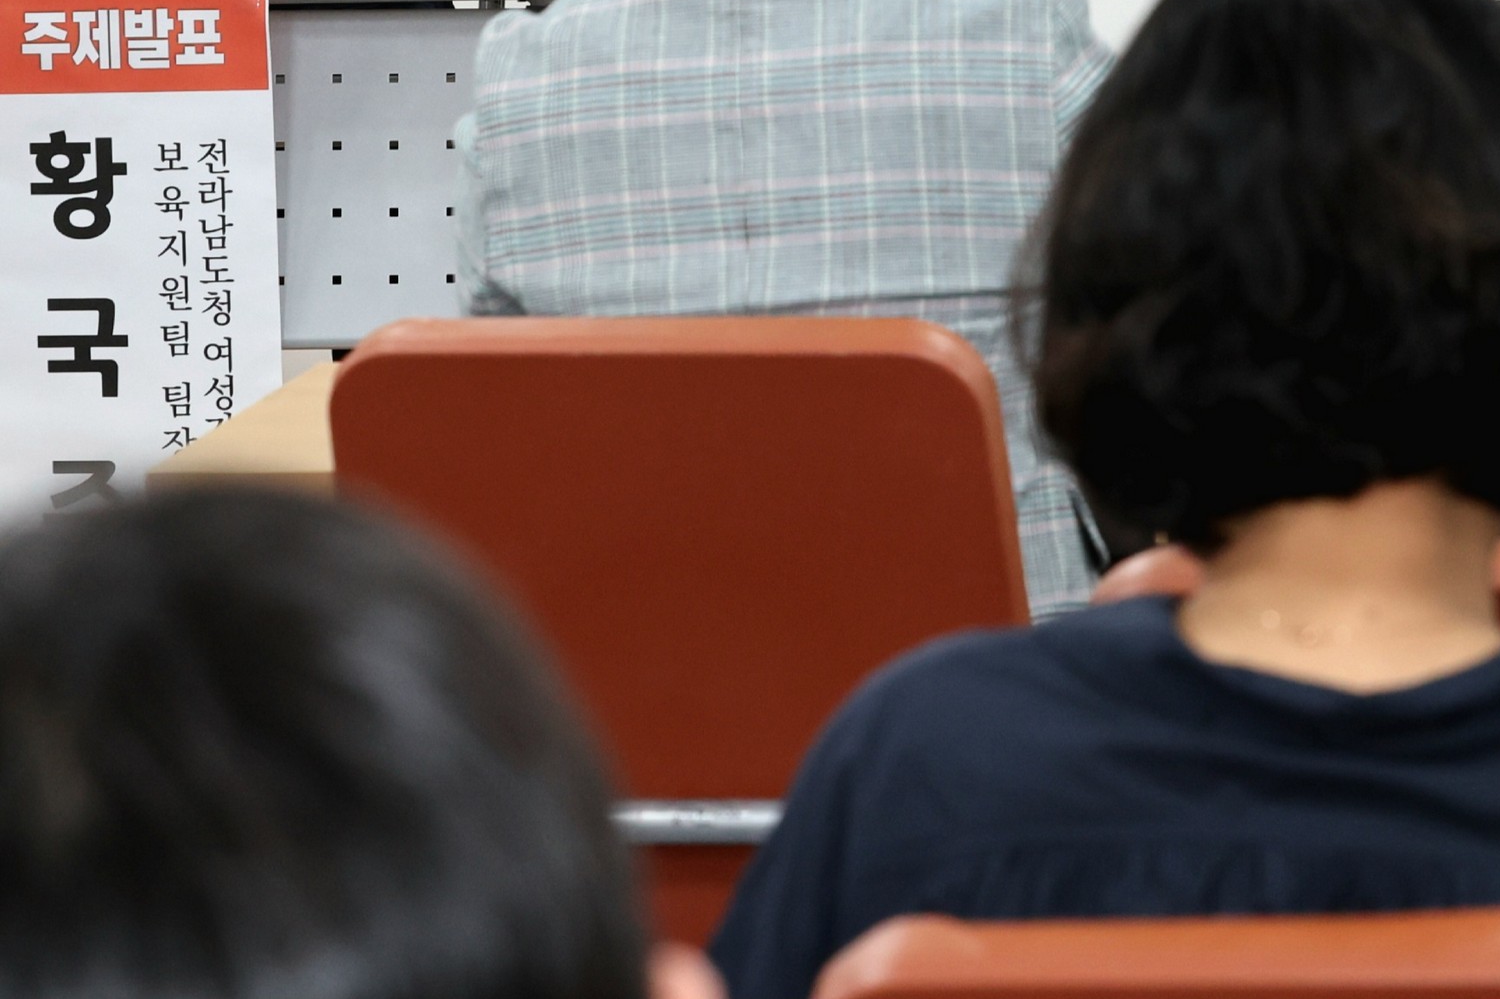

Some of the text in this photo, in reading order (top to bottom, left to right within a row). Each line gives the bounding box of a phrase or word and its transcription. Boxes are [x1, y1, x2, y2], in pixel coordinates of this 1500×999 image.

[21, 8, 225, 71] 주제발표
[153, 142, 193, 358] 보육지원팀
[197, 138, 235, 328] 전라남도청
